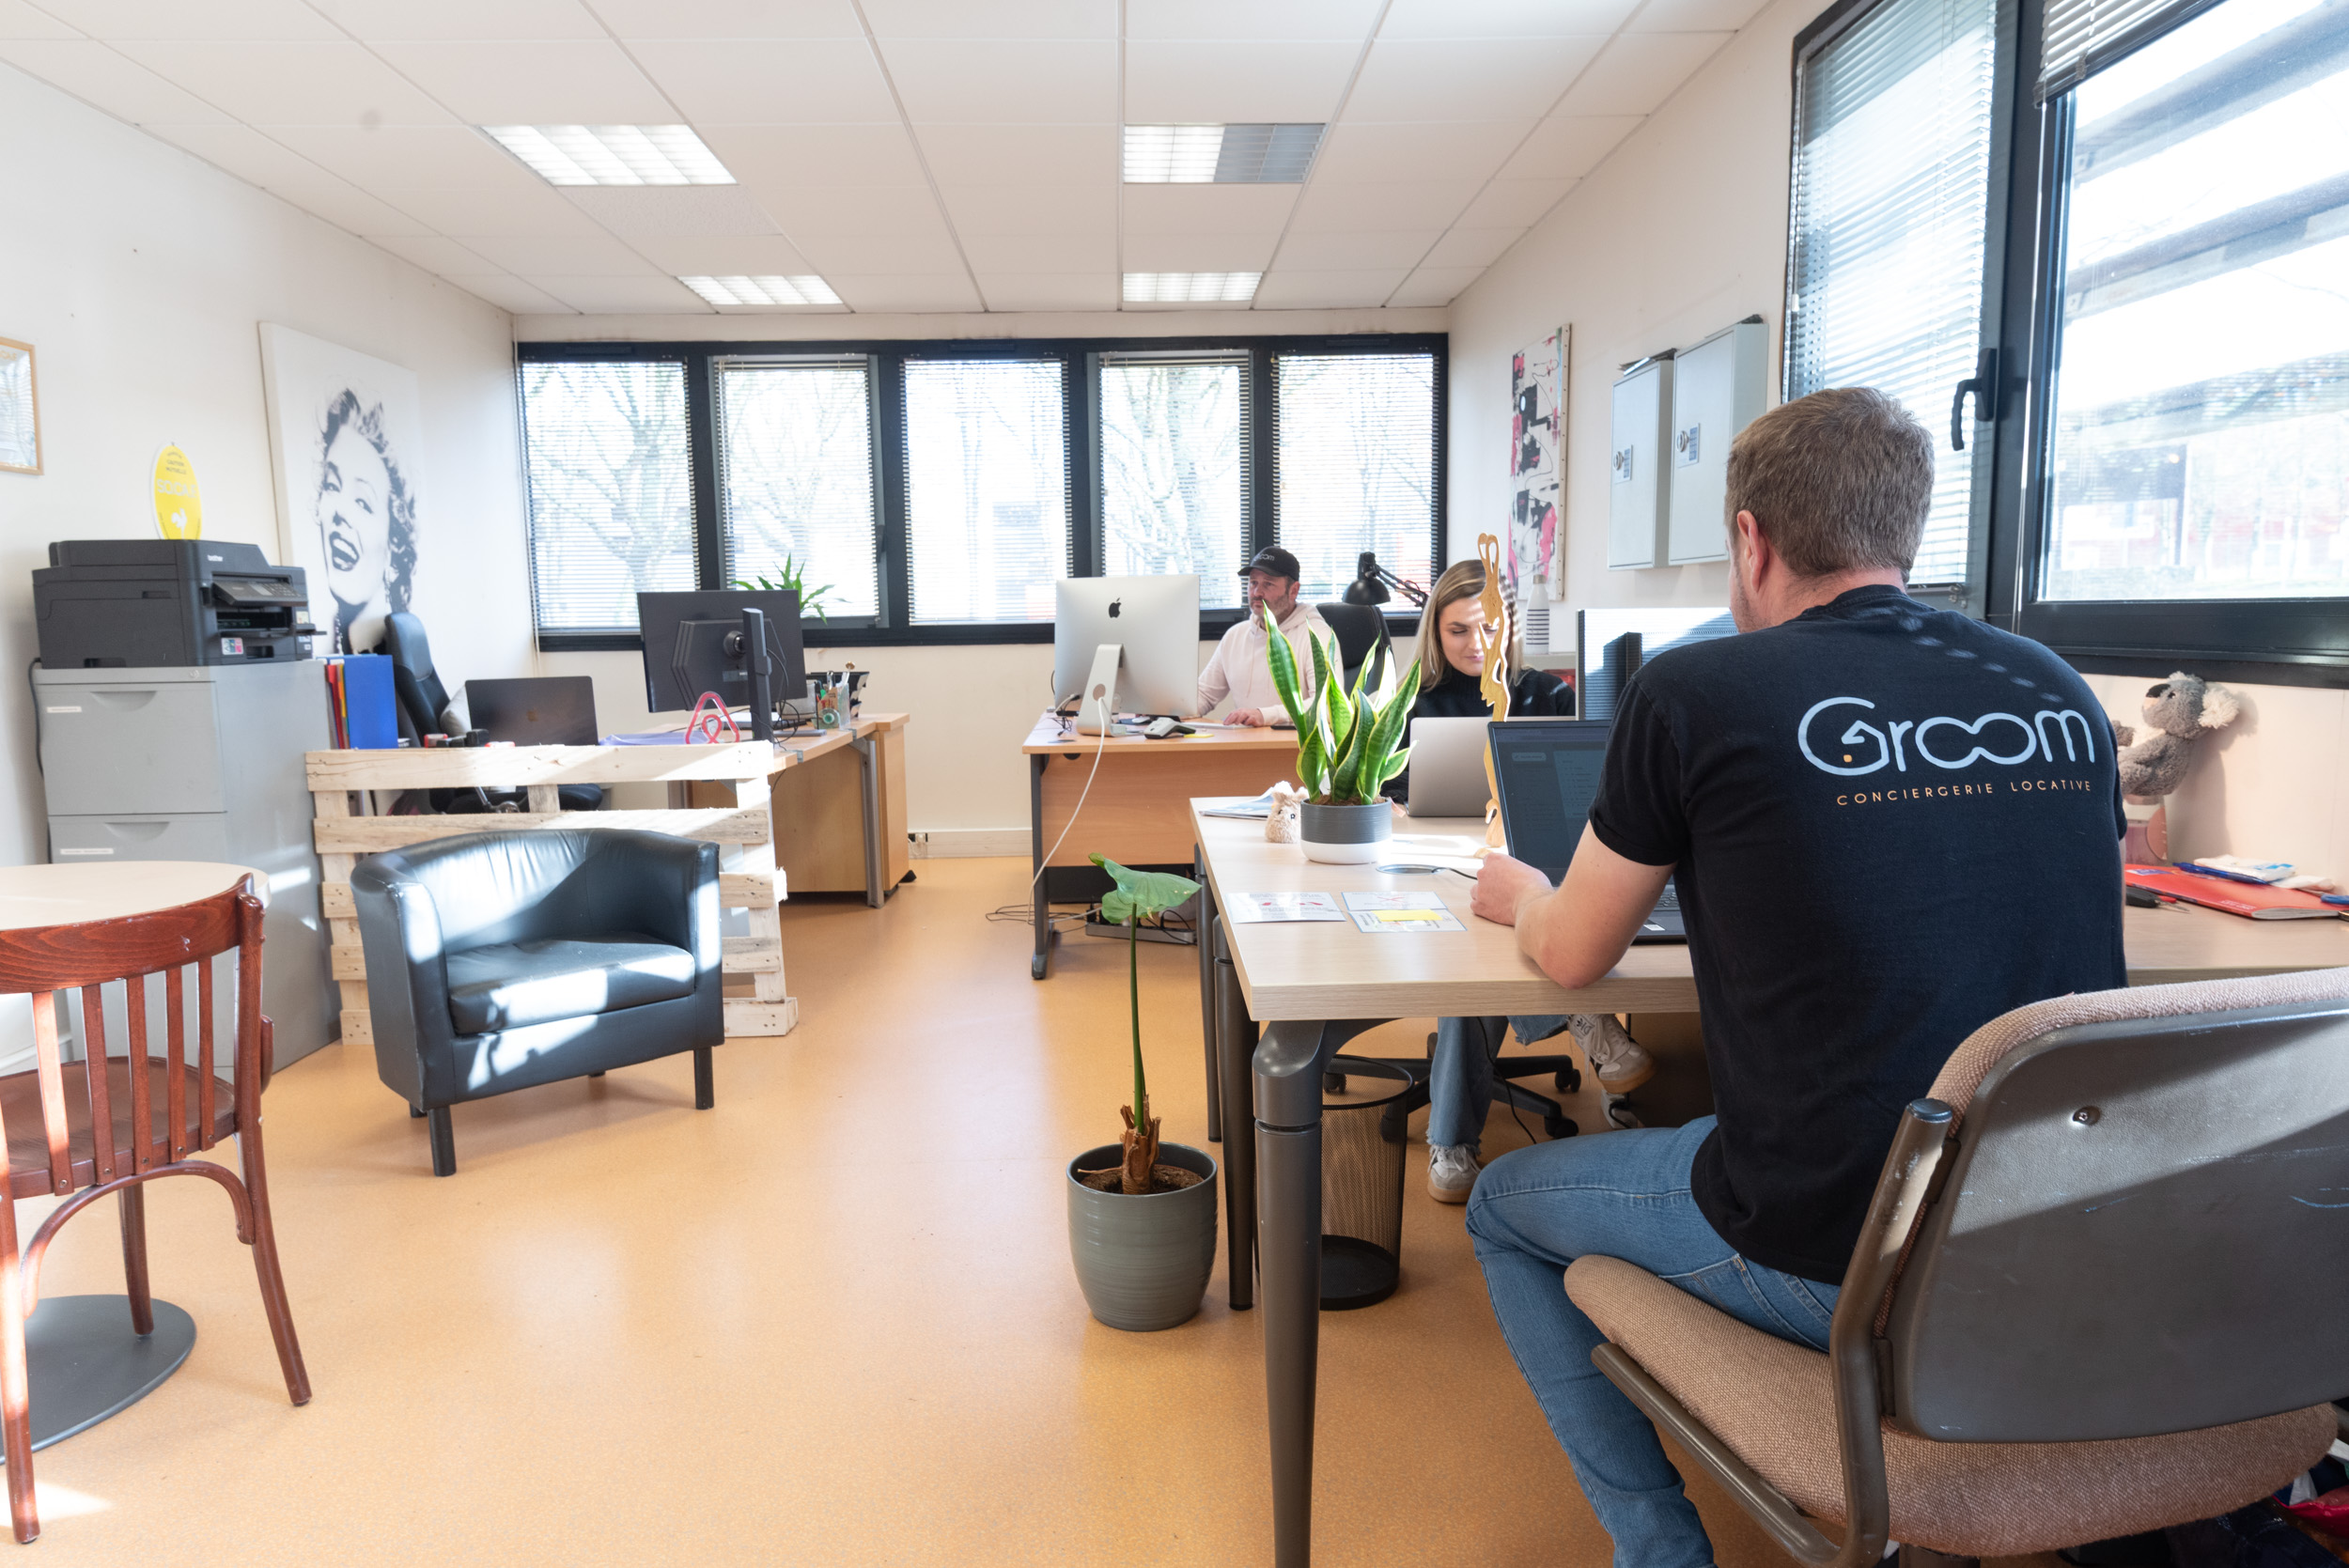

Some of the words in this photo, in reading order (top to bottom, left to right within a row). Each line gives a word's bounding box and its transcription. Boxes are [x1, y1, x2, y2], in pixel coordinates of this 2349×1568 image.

[1797, 696, 2095, 776] Groom
[1836, 782, 1994, 806] CONCIERGERIE
[2010, 779, 2092, 793] LOCATIVE
